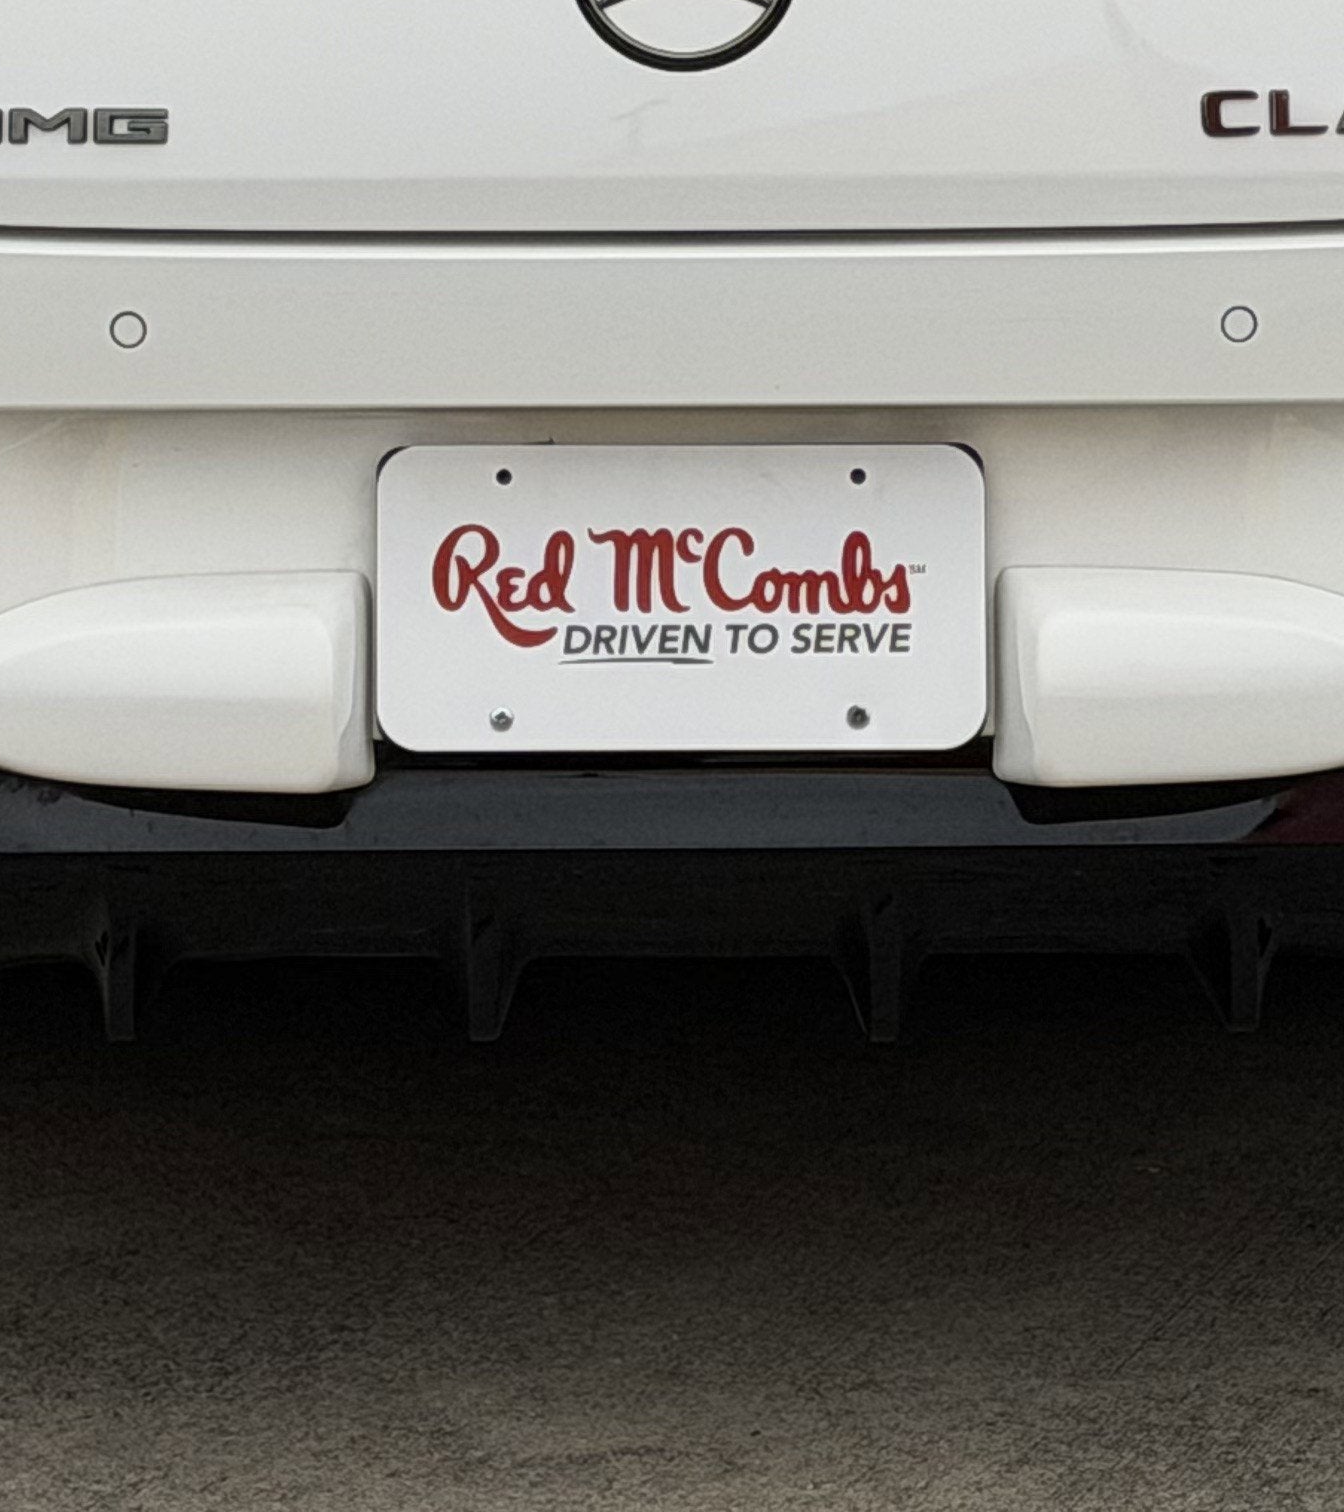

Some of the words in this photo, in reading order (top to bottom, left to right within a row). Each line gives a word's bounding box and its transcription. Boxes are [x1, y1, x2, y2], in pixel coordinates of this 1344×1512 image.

[432, 523, 576, 648] Red
[587, 527, 910, 615] McCombs
[562, 624, 713, 656] DRIVEN
[728, 624, 780, 655] TO
[790, 623, 913, 655] SERVE
